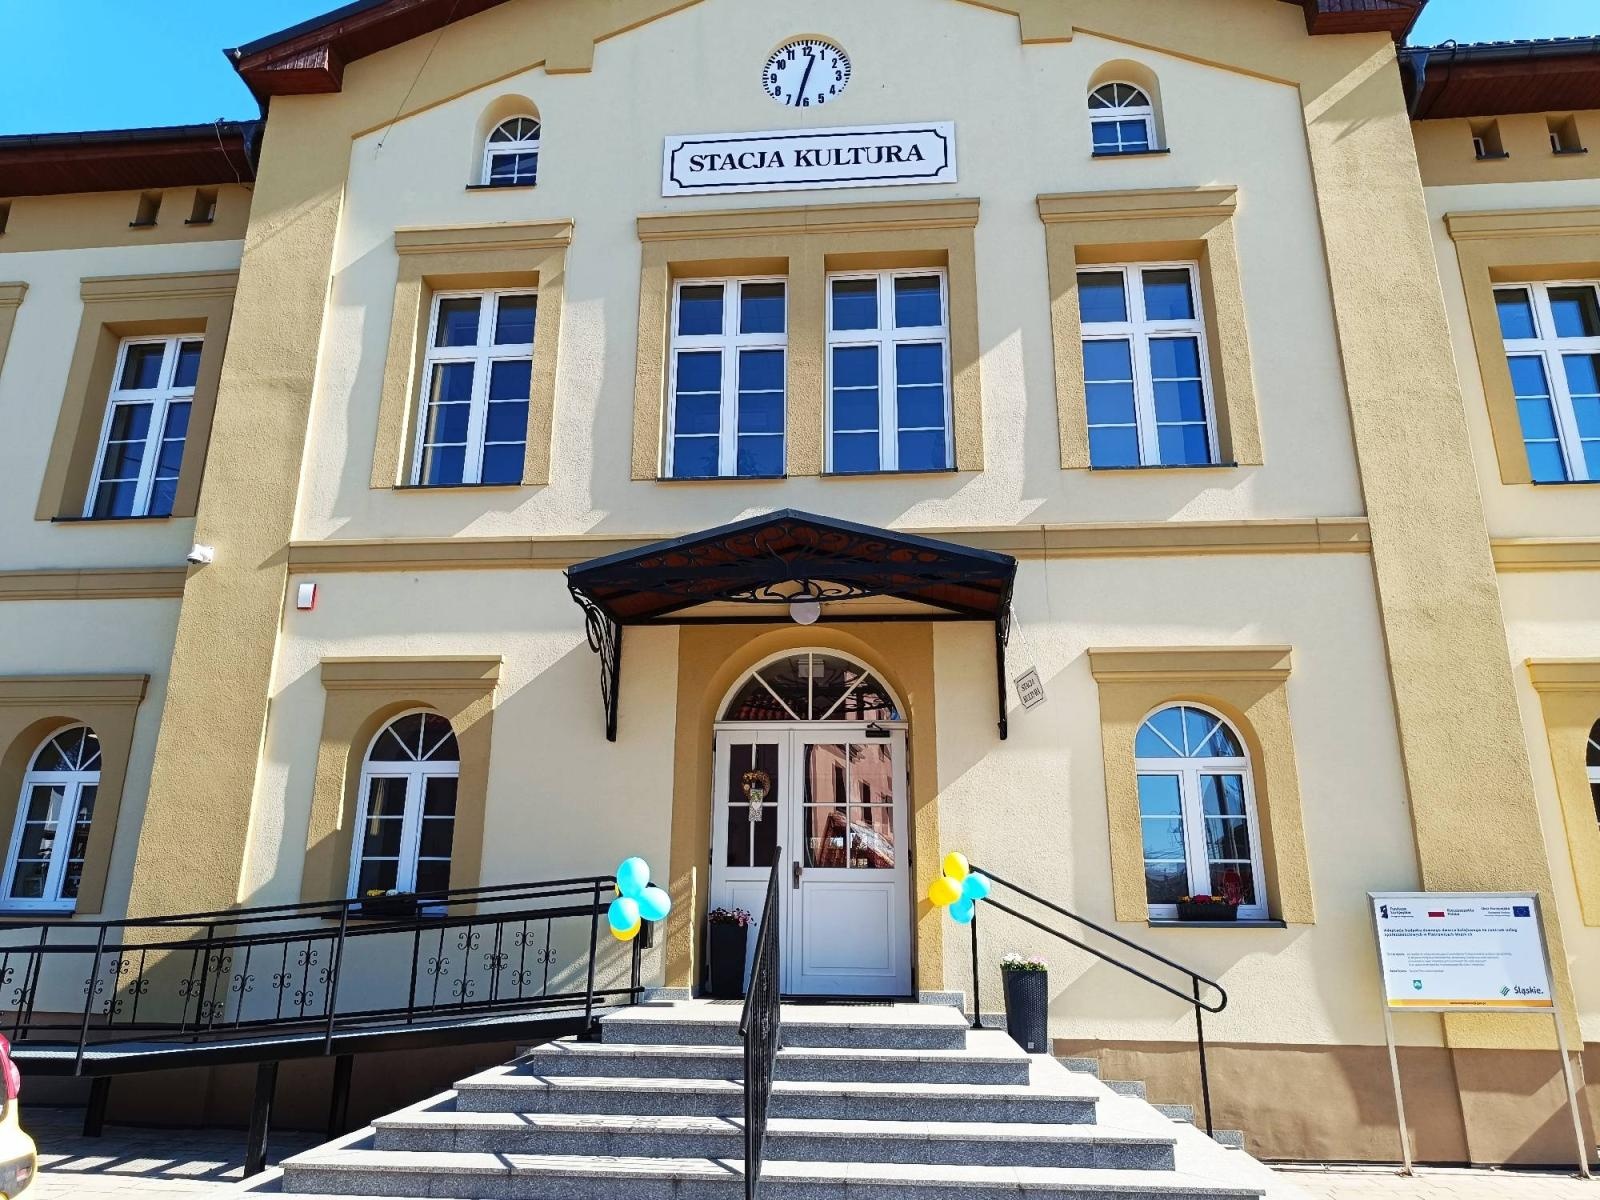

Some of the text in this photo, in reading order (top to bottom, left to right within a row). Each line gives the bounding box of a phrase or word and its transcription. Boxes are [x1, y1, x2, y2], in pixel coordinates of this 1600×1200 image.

[786, 49, 795, 60] 11
[802, 46, 812, 56] 12
[820, 50, 825, 60] 1
[776, 59, 786, 70] 10
[831, 58, 838, 68] 2
[770, 73, 777, 84] 9
[835, 70, 842, 81] 3
[775, 86, 781, 97] 8
[829, 84, 836, 95] 4
[785, 94, 791, 105] 7
[802, 97, 809, 107] 6
[818, 93, 825, 103] 5
[689, 143, 926, 172] STACJA KULTURA
[1513, 984, 1544, 996] Śląskie.
